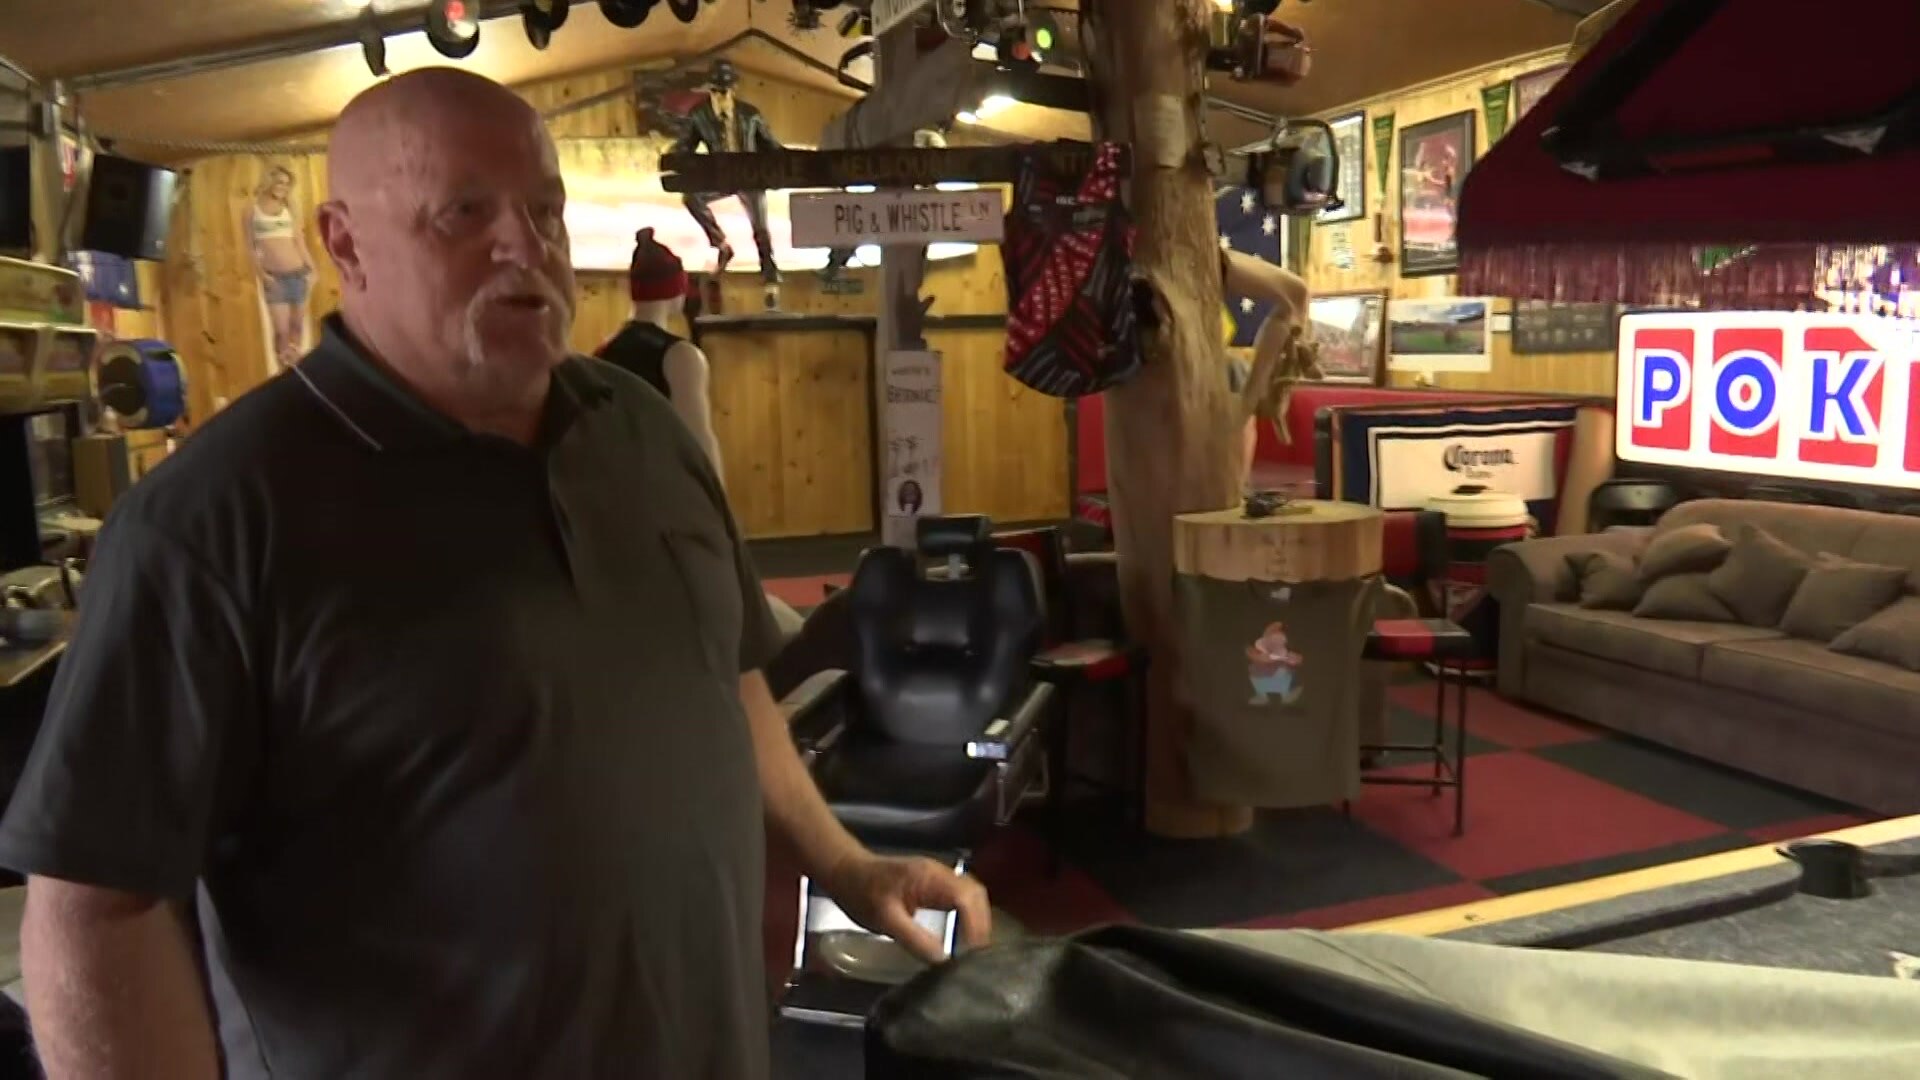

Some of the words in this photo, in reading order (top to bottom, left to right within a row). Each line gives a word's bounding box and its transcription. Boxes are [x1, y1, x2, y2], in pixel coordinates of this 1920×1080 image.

[834, 203, 863, 234] PIG
[870, 211, 881, 232] &
[886, 202, 963, 232] WHISTLE
[1442, 444, 1514, 472] Corona
